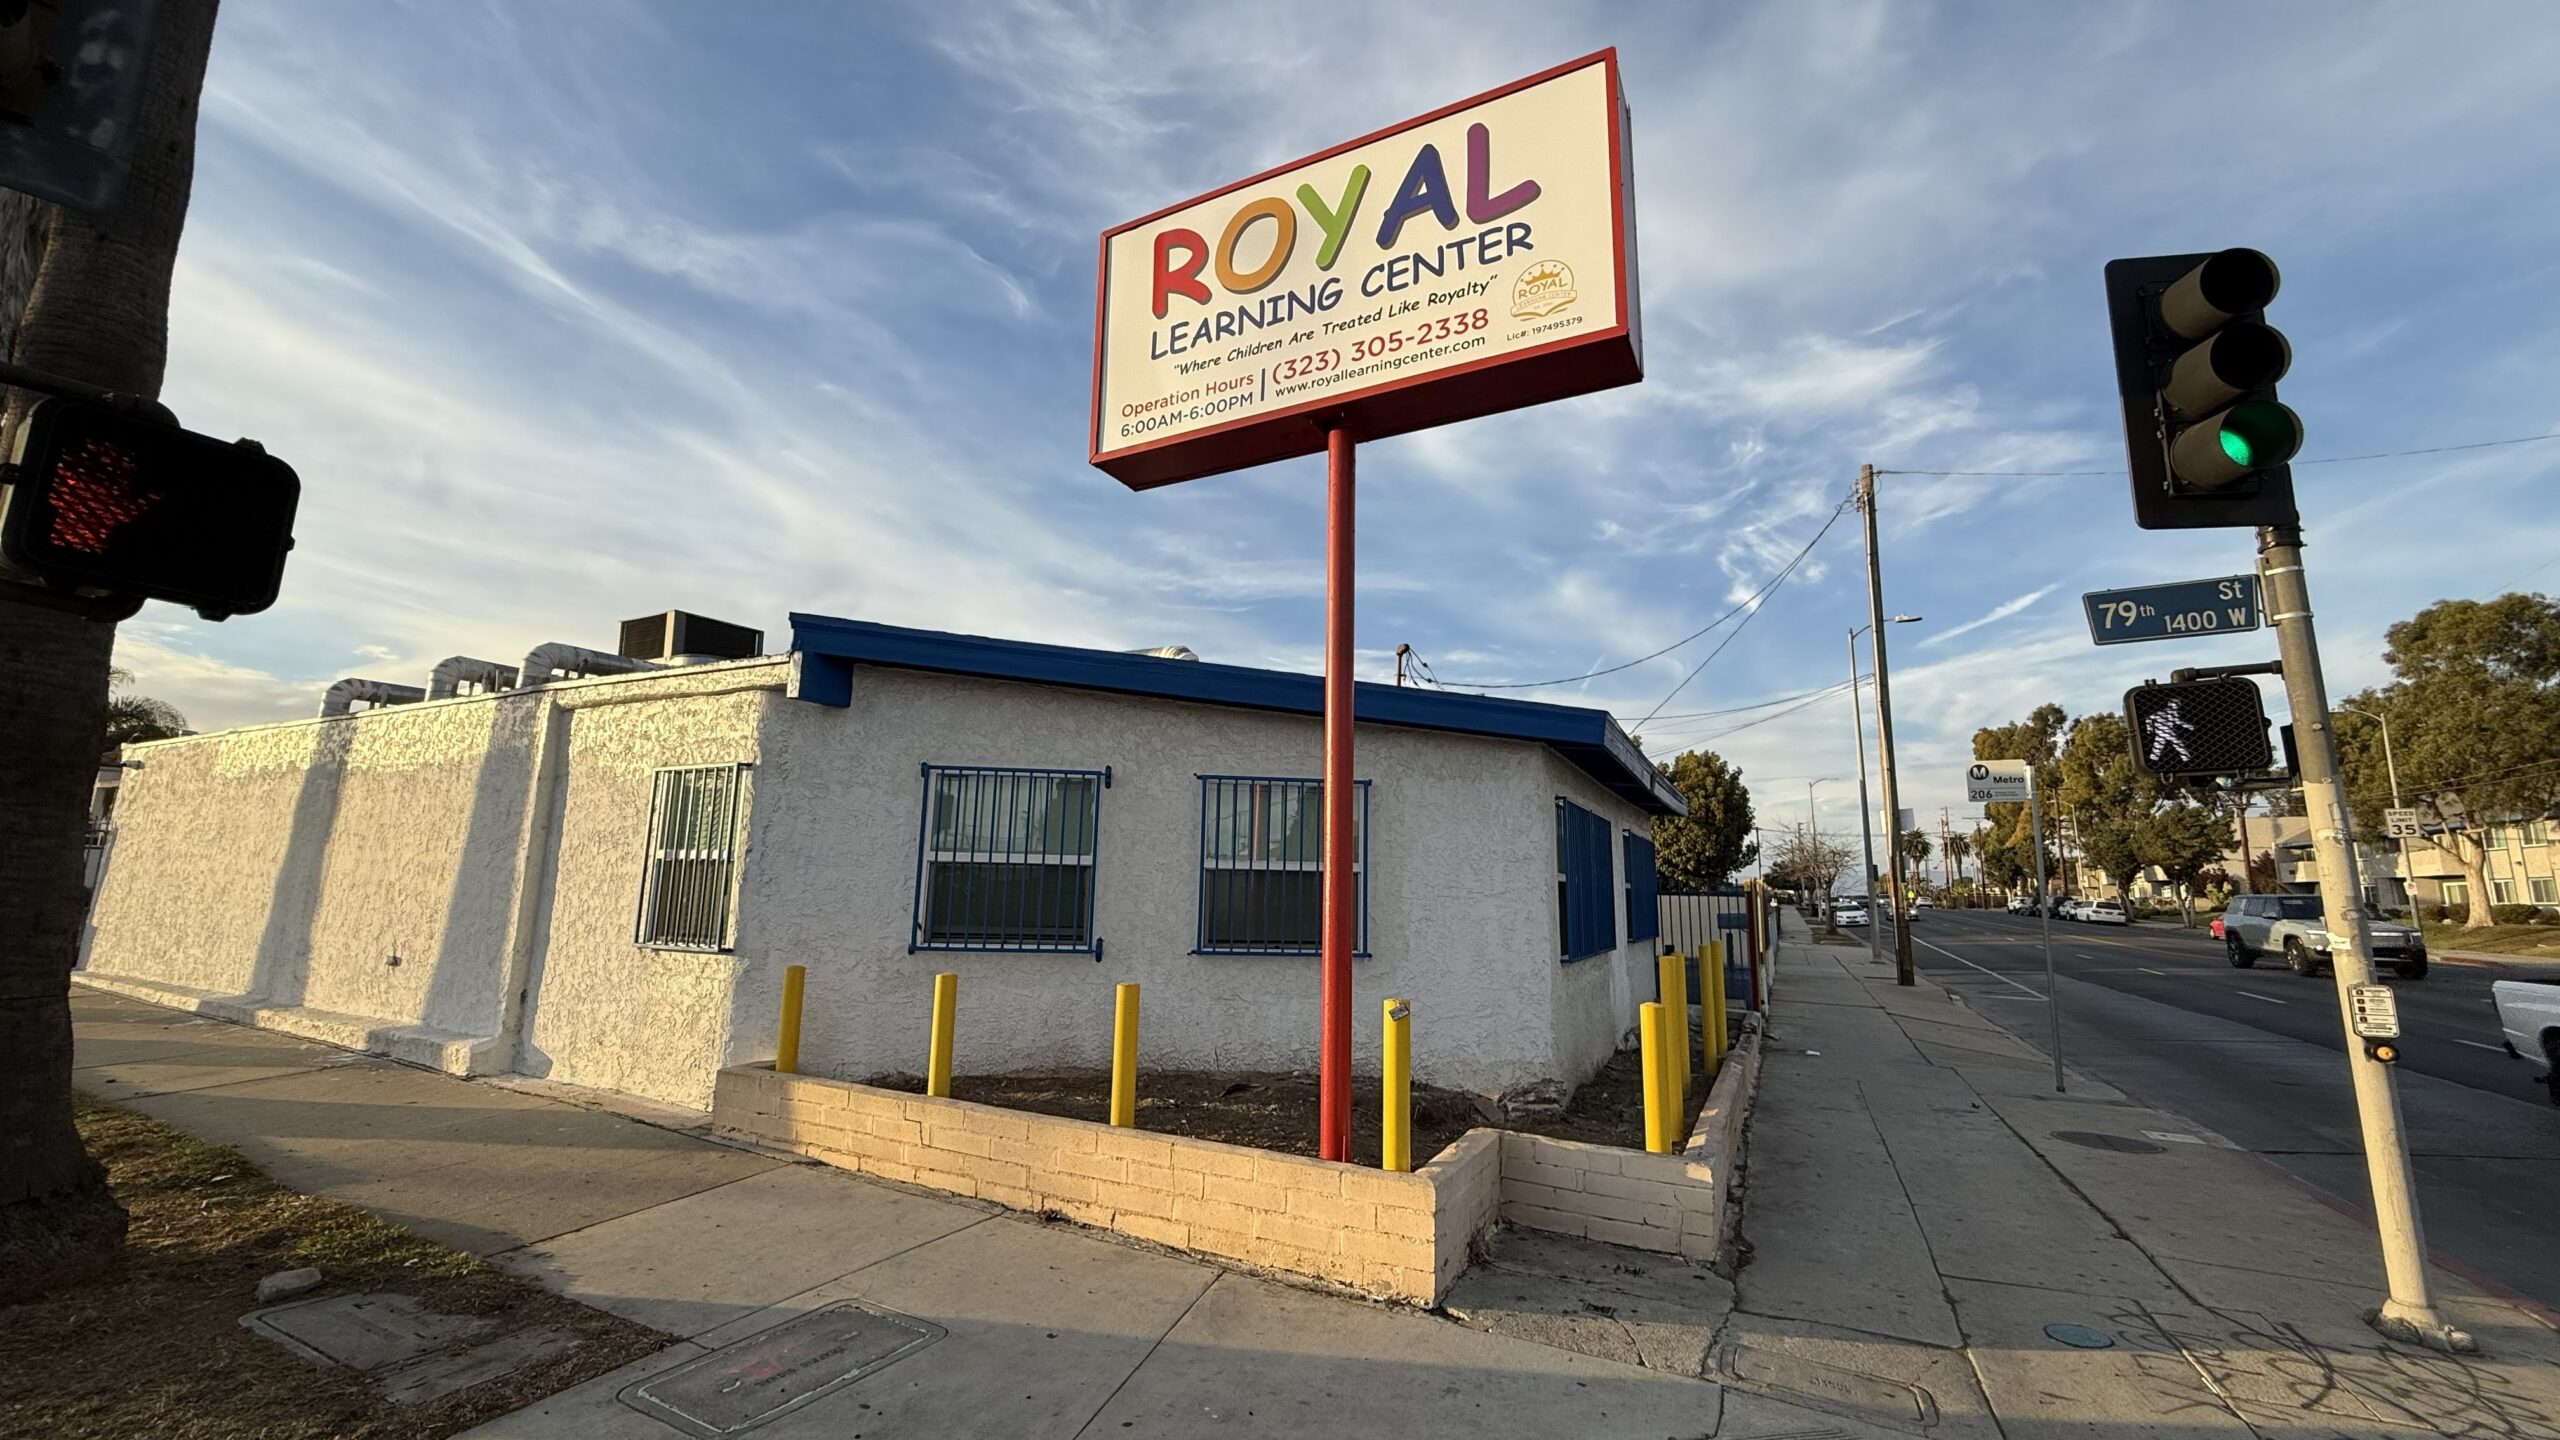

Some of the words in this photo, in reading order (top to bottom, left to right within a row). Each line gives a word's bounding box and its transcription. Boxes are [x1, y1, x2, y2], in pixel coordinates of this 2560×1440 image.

[1152, 122, 1541, 319] ROYAL
[1150, 276, 1344, 360] LEARNING
[1360, 222, 1534, 298] CENTER
[1518, 277, 1568, 299] ROYAL
[1227, 337, 1283, 362] Children
[1288, 328, 1315, 346] Are
[1322, 310, 1382, 336] Treated
[1388, 299, 1420, 318] Like
[1272, 348, 1342, 385] (323)
[1351, 308, 1489, 362] 305-2338
[1506, 330, 1530, 341] Lic#:
[1532, 315, 1583, 335] 197495379
[1275, 334, 1486, 398] www.royallearningcenter.com
[1120, 391, 1254, 438] 6:00AM-6:00PM
[1122, 387, 1200, 418] Operation
[1205, 373, 1255, 397] Hours
[2098, 600, 2155, 629] 79th
[2218, 581, 2243, 600] St
[2163, 610, 2217, 633] 1400
[2227, 608, 2246, 626] W
[1971, 789, 1993, 799] 206
[1993, 776, 2024, 784] Metro
[2392, 824, 2417, 835] 35
